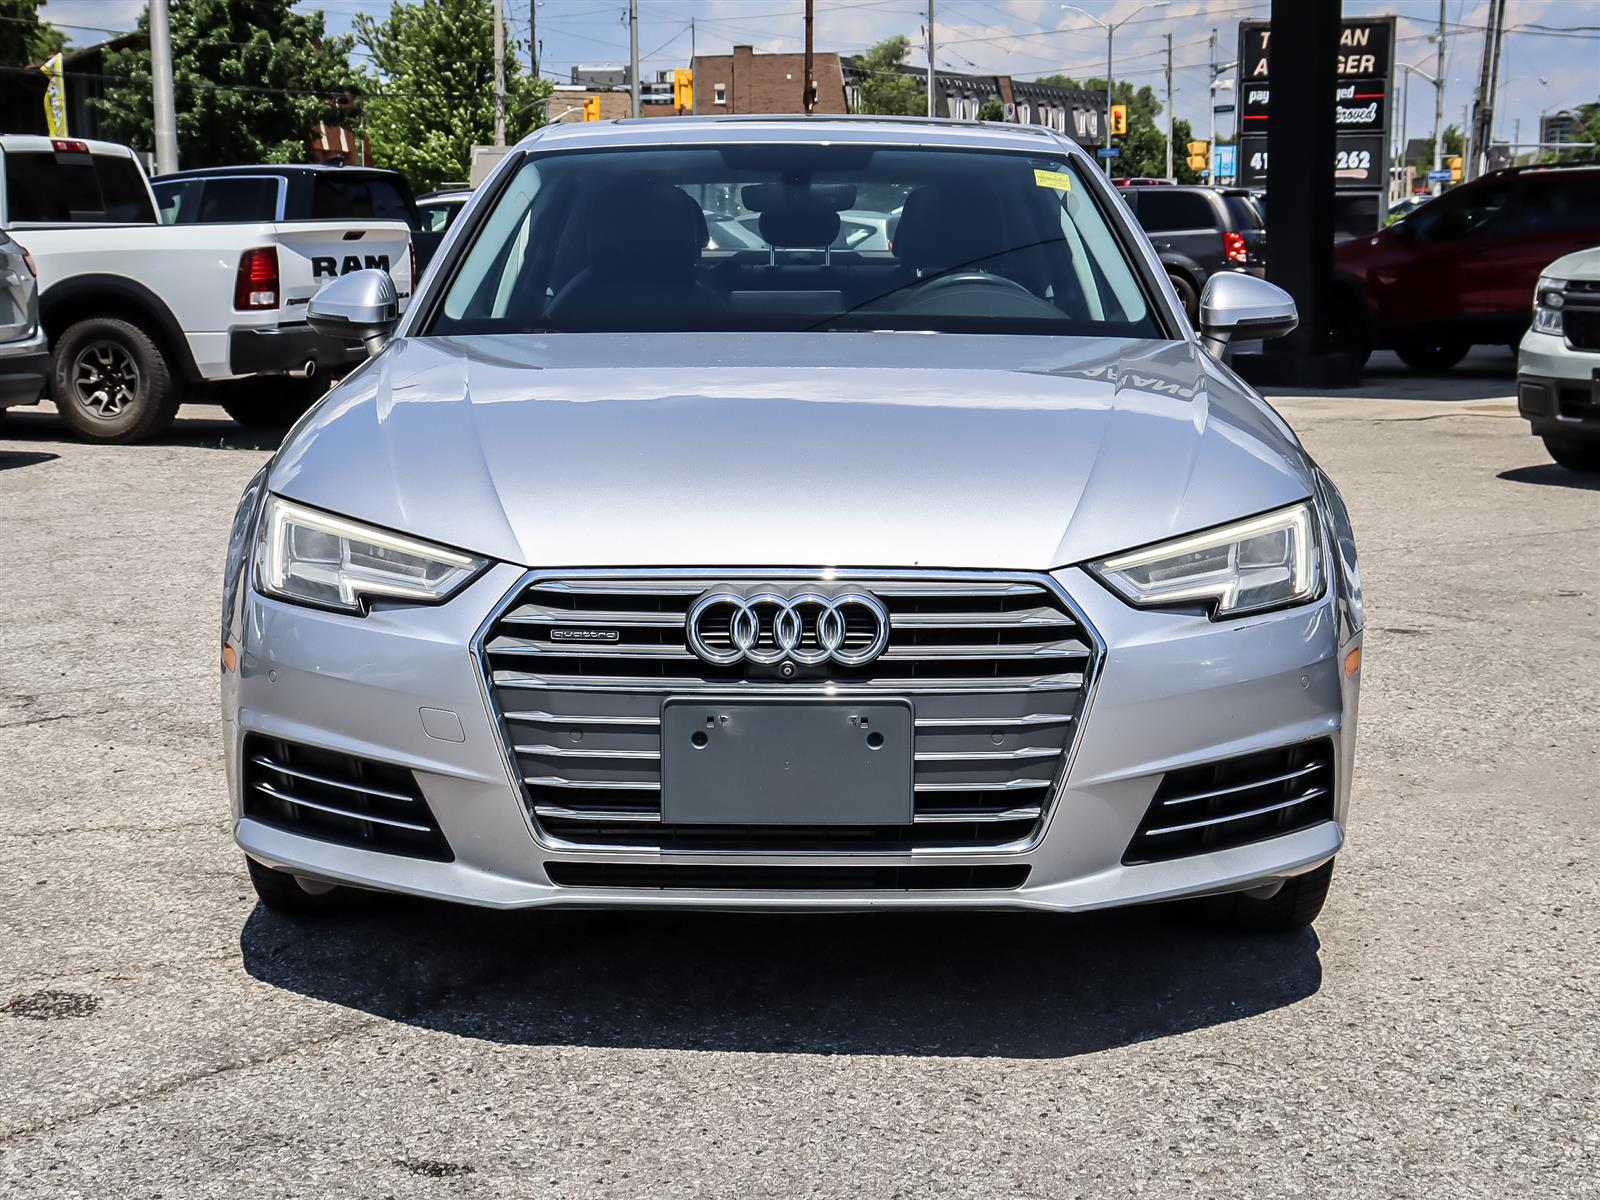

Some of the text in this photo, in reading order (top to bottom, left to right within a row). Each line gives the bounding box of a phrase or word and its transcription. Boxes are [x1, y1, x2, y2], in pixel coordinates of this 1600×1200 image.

[1336, 102, 1377, 123] roved
[312, 255, 390, 277] RAM
[553, 630, 616, 639] quattro
